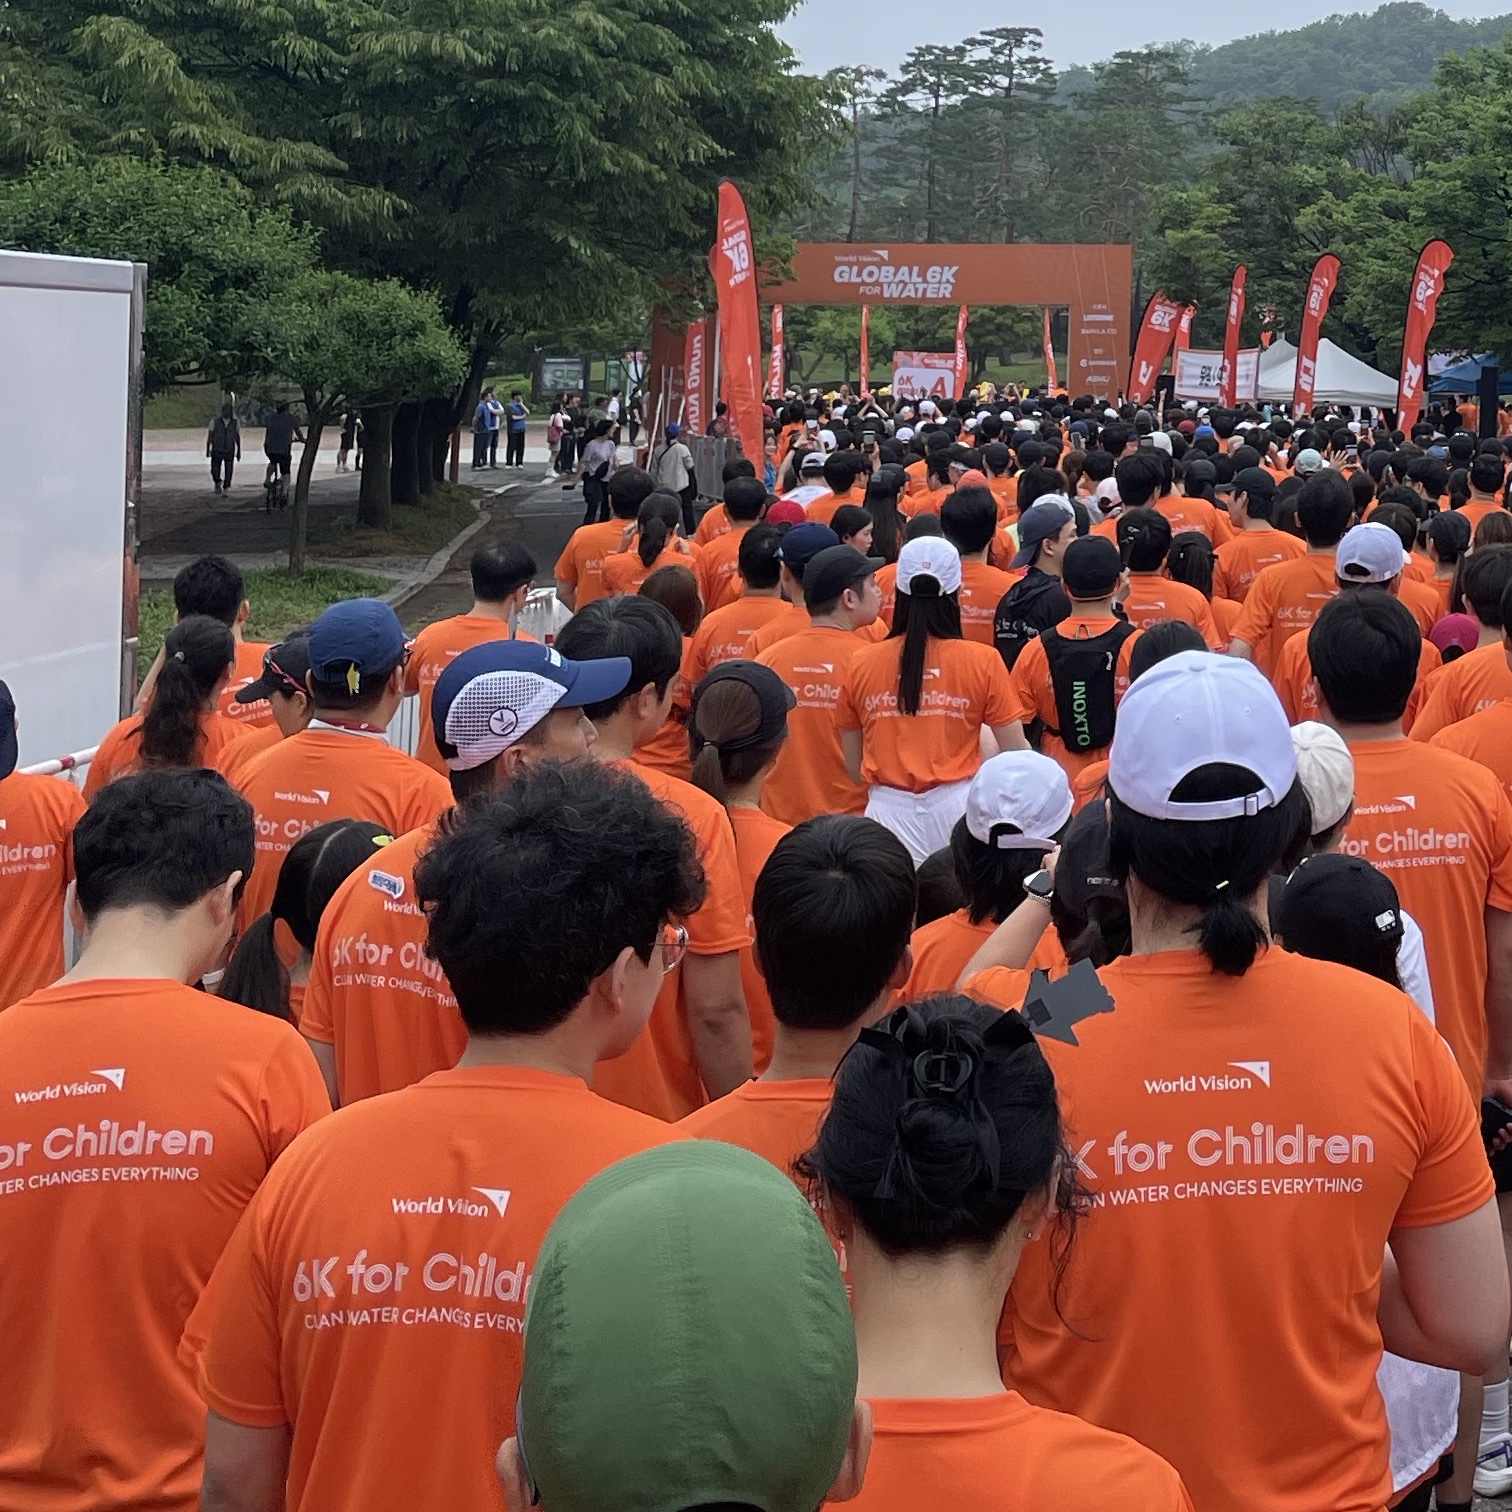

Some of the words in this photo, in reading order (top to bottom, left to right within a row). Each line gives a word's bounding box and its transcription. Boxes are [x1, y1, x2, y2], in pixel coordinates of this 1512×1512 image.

[833, 265, 922, 283] GLOBAL
[926, 266, 960, 283] 6K
[860, 286, 881, 295] FOR
[883, 283, 953, 298] WATER
[1150, 311, 1177, 330] 6K
[921, 690, 971, 709] hildren
[1073, 681, 1091, 747] INOXTO
[1380, 803, 1406, 813] Vision
[1375, 827, 1470, 854] Children
[1412, 855, 1466, 867] EVERYTHING
[384, 899, 414, 915] World
[356, 932, 393, 967] for
[14, 1084, 61, 1105] World
[63, 1081, 108, 1098] Vision
[1143, 1075, 1197, 1095] World
[1199, 1074, 1252, 1092] Vision
[0, 1140, 32, 1170] or
[42, 1119, 214, 1160] Children
[1107, 1129, 1174, 1176] for
[1186, 1120, 1375, 1168] Children
[28, 1167, 99, 1190] CHANGES
[101, 1166, 200, 1182] EVERYTHING
[1109, 1186, 1170, 1206] WATER
[1173, 1179, 1258, 1199] CHANGES
[1260, 1176, 1364, 1197] EVERYTHING
[391, 1196, 444, 1215] World
[293, 1255, 341, 1303] 6K
[346, 1248, 410, 1296] for
[347, 1306, 399, 1326] WATER
